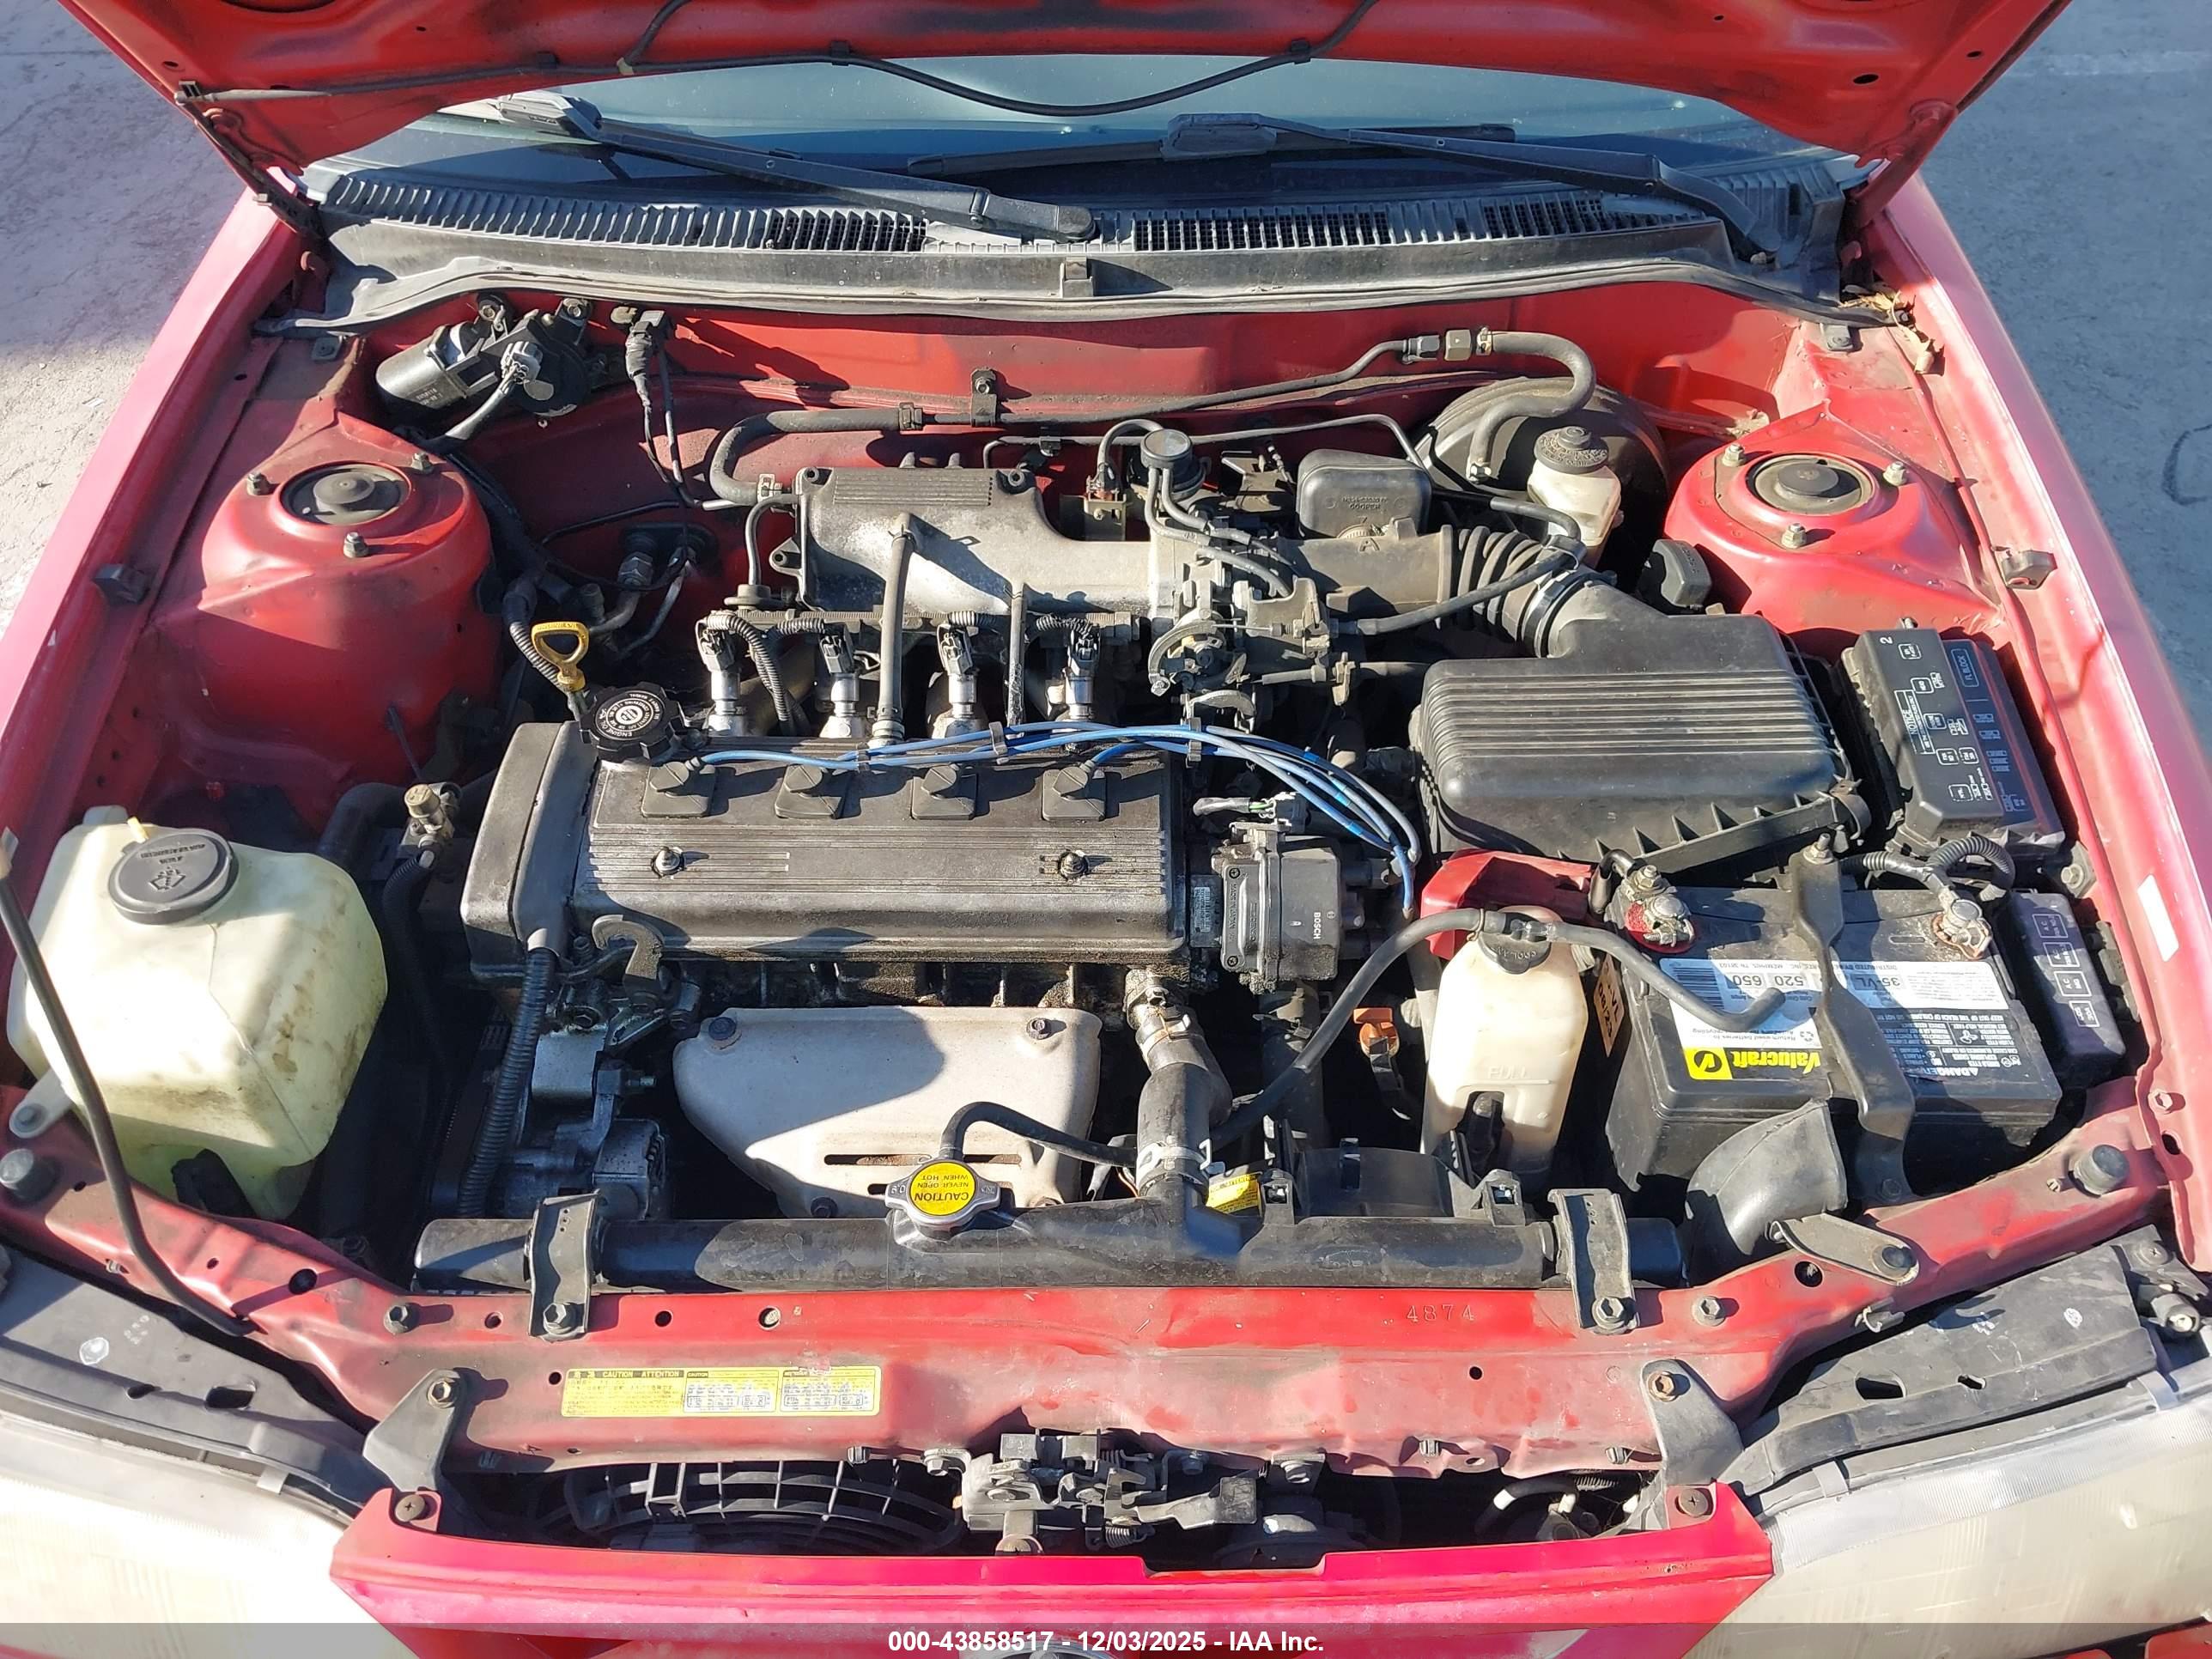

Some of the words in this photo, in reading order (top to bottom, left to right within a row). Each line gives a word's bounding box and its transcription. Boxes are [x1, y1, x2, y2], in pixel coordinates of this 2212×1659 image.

[1902, 709, 1917, 735] NOTICE
[605, 728, 632, 737] ENGINE
[1733, 975, 1762, 986] 650
[1774, 975, 1803, 986] 520
[1855, 976, 1900, 988] 35-VL
[1730, 1049, 1821, 1074] Valucraft
[1487, 1065, 1530, 1079] FULL
[915, 1192, 969, 1201] CAUTION
[1406, 1304, 1474, 1323] 4874
